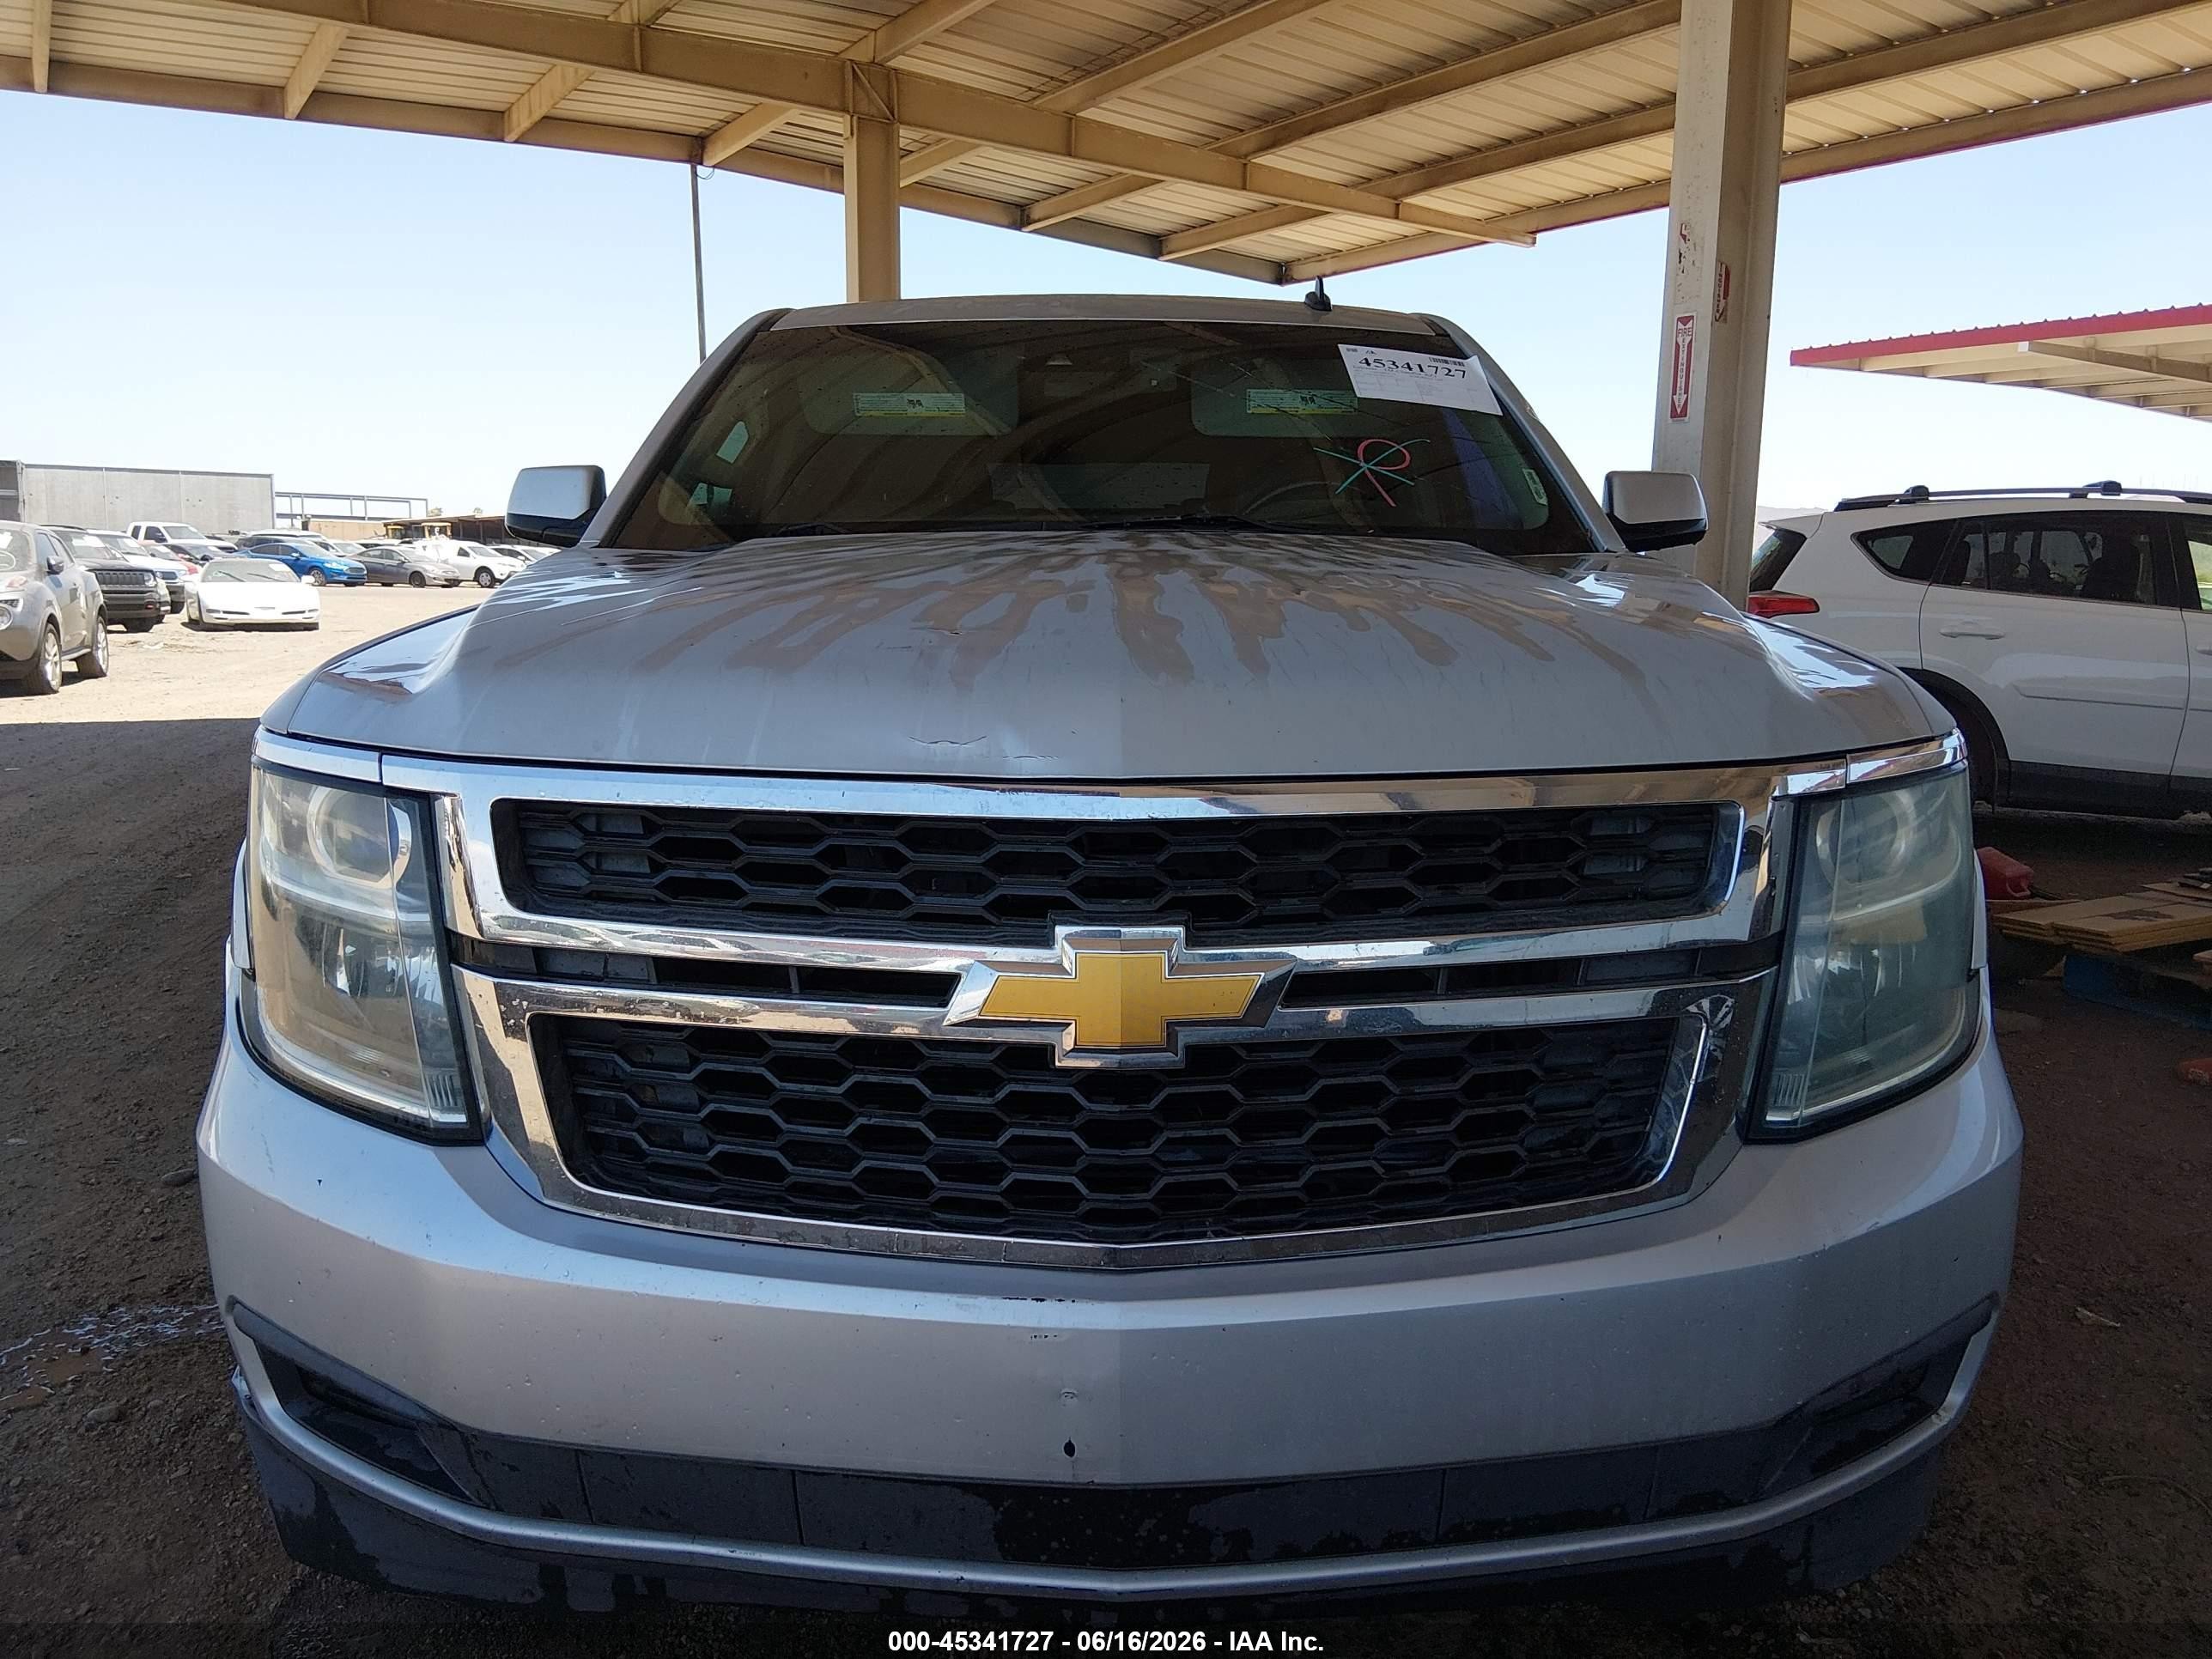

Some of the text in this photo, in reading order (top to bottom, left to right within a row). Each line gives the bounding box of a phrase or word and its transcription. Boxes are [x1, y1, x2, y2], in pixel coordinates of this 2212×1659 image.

[1677, 327, 1692, 337] FIRE
[1358, 357, 1467, 379] 45341727
[1677, 337, 1686, 409] EXTINGUISHER
